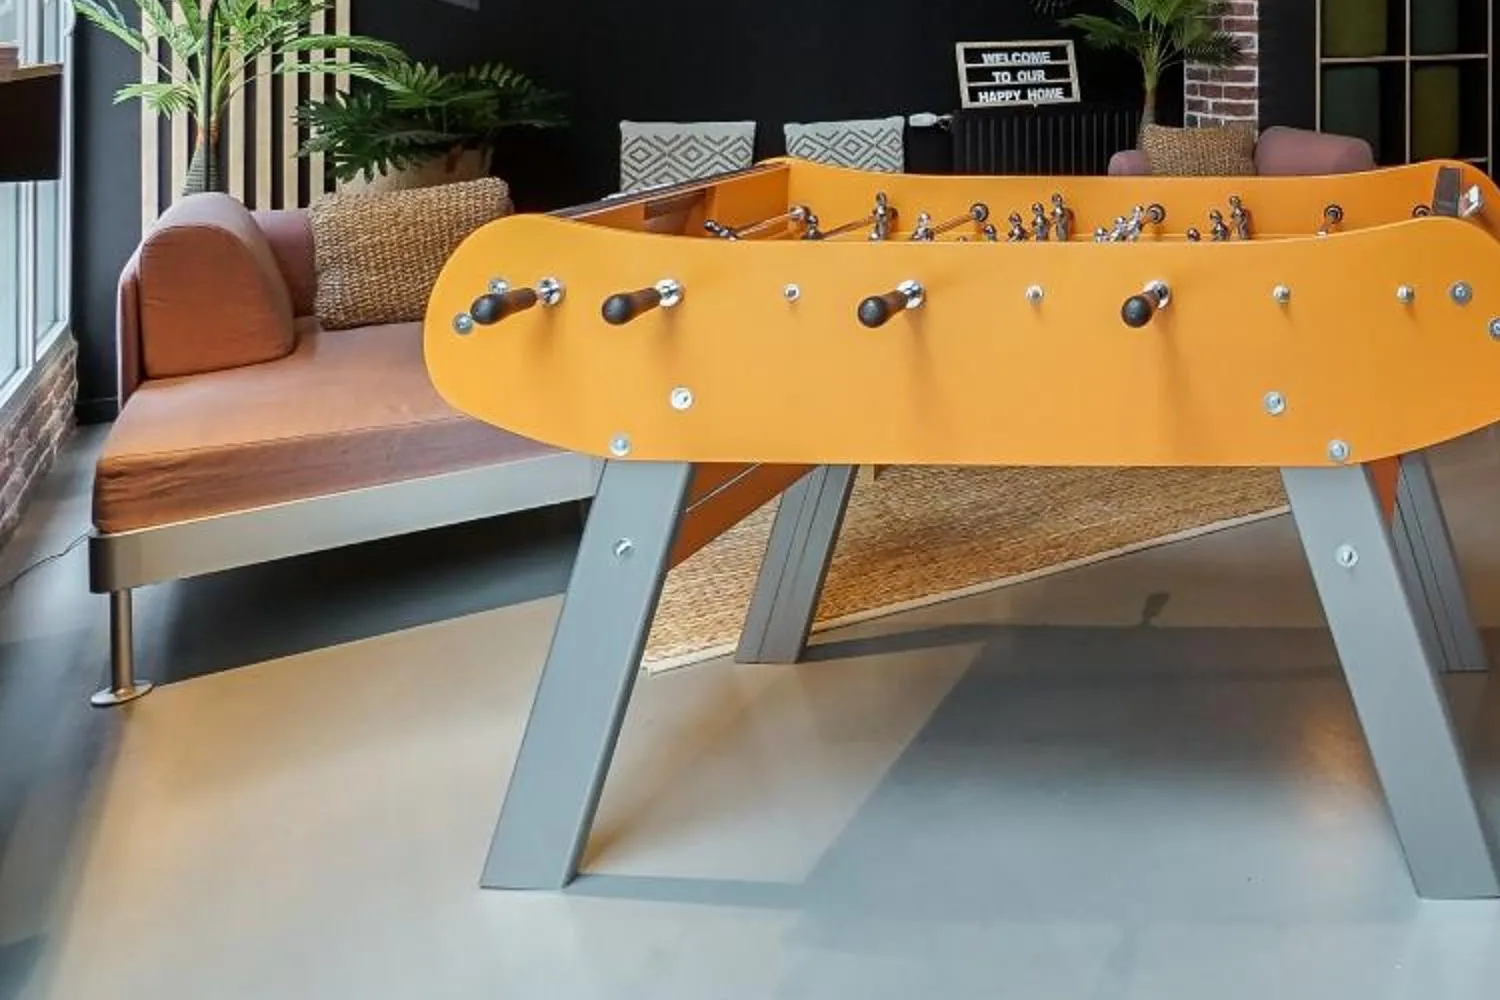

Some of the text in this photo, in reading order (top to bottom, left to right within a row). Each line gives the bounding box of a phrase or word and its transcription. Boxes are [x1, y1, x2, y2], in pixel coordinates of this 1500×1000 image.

[981, 51, 1051, 65] WELCOME
[991, 69, 1046, 83] TO OUR
[977, 87, 1065, 104] HAPPY HOME
